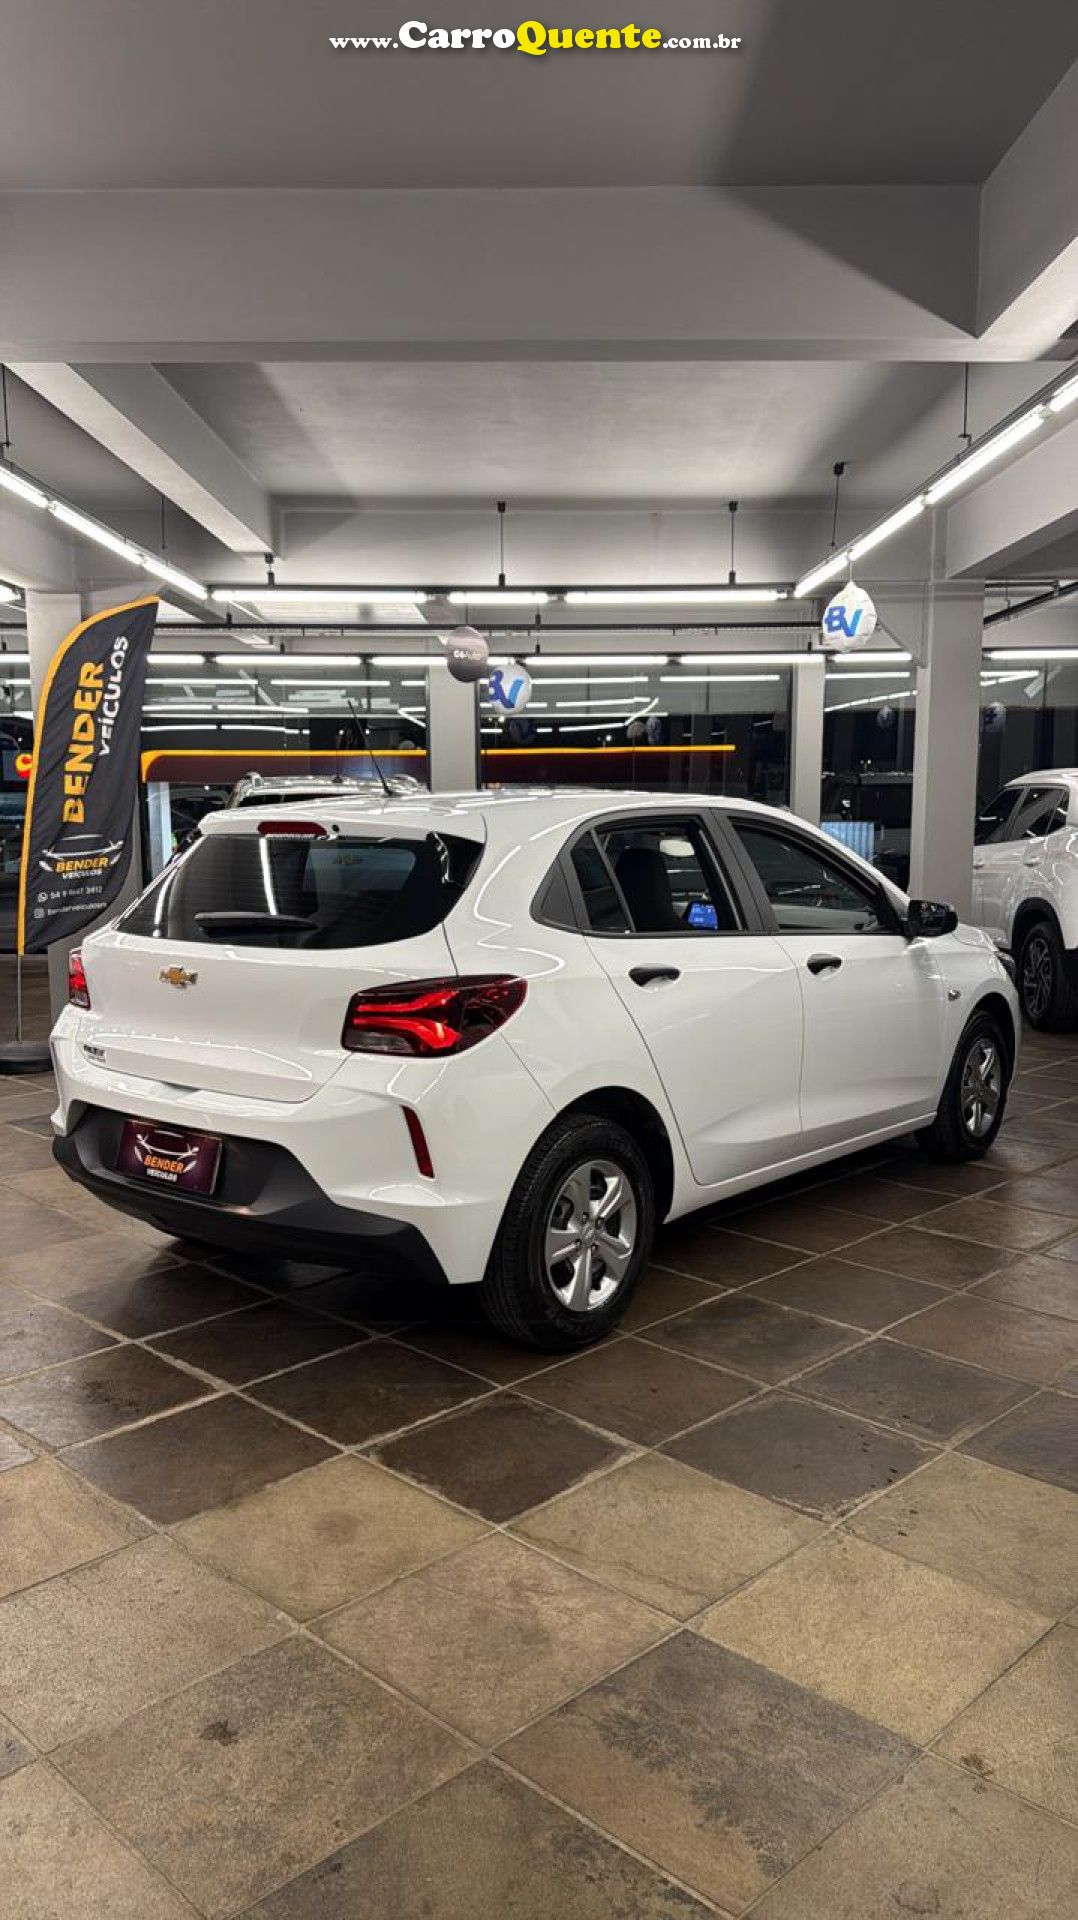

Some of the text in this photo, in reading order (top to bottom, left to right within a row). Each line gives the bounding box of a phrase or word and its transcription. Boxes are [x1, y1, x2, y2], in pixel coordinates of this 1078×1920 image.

[824, 606, 863, 636] BV
[98, 636, 129, 756] VEÍCULOS
[63, 661, 104, 823] BENDER
[56, 857, 109, 872] BENDER
[143, 1154, 184, 1173] BENDER
